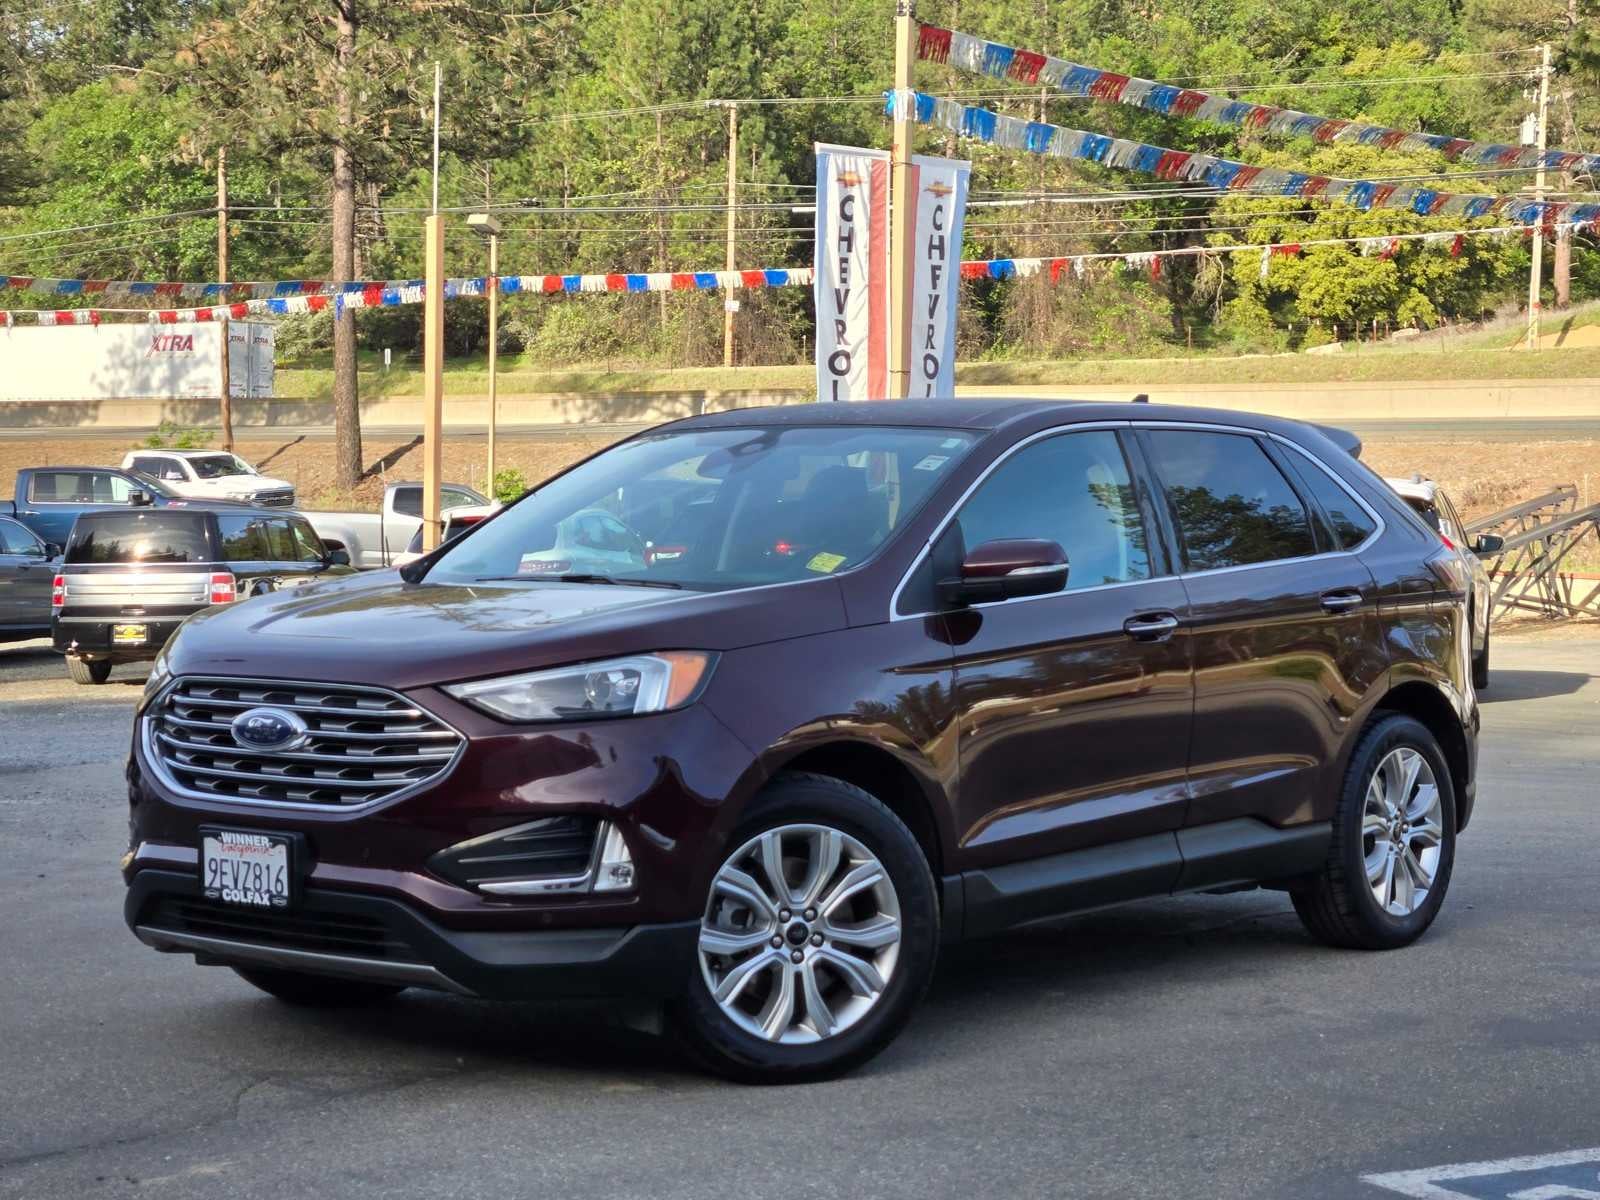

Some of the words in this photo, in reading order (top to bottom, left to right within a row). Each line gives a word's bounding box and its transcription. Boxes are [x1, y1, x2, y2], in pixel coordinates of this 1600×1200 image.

[146, 334, 194, 357] XTRA
[228, 335, 246, 344] XTRA
[220, 831, 270, 848] WINNER
[208, 857, 285, 896] 9EVZ816
[222, 888, 270, 906] COLFAX
